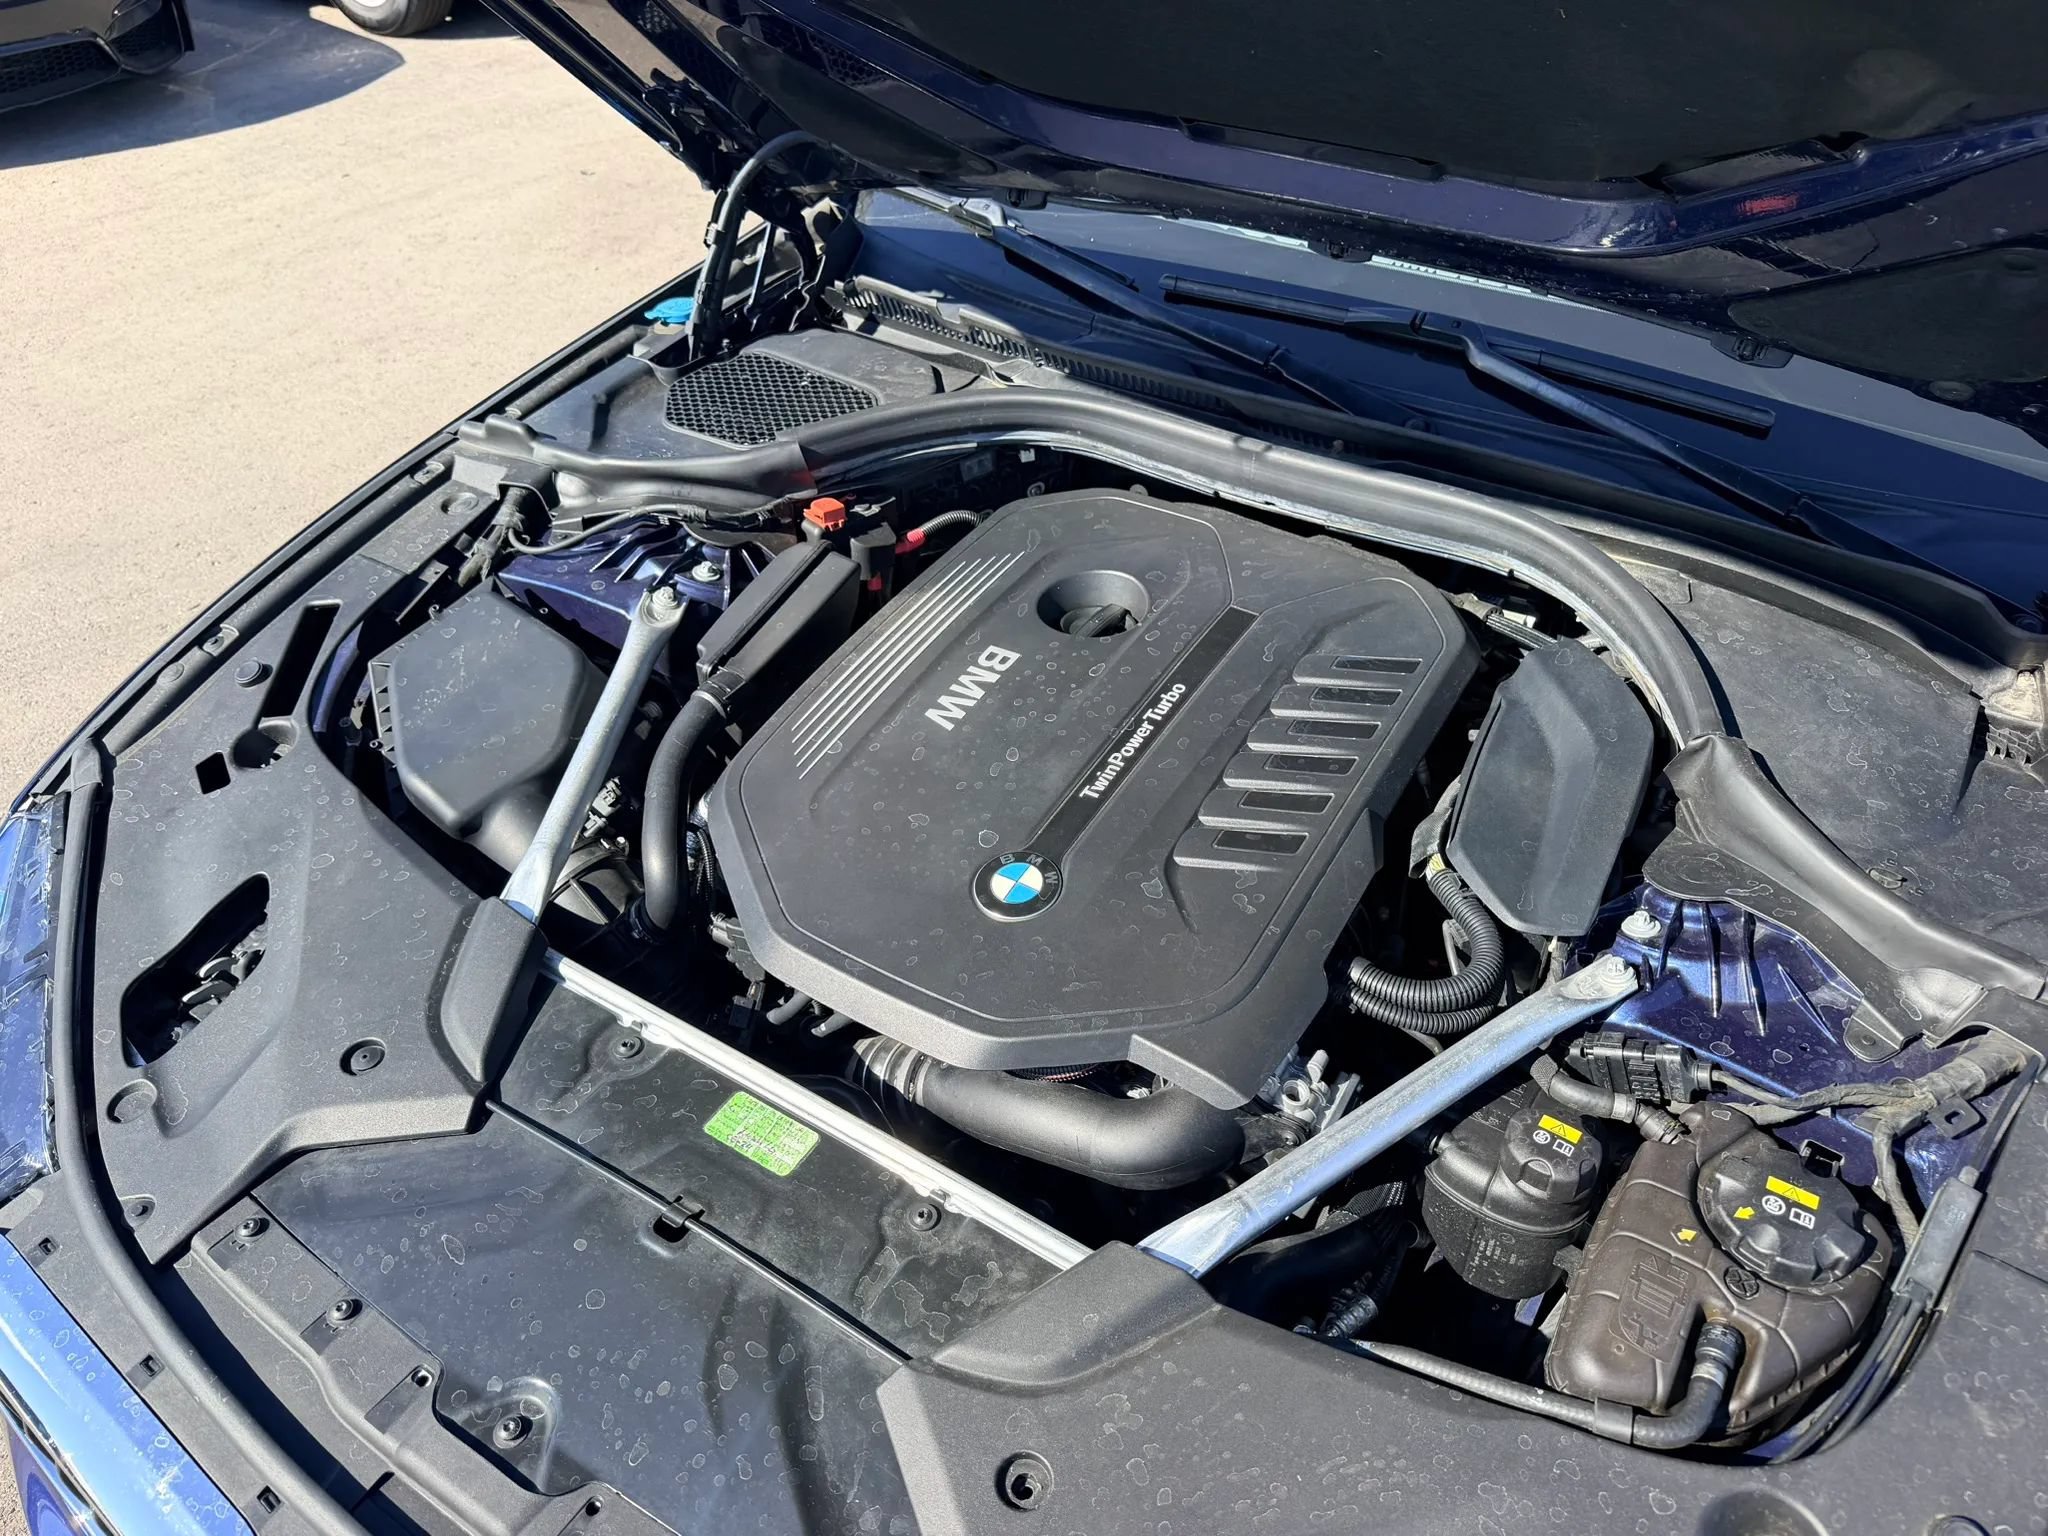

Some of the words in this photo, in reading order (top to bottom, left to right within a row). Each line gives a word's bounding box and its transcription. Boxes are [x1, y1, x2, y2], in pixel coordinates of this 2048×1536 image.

[925, 645, 1022, 731] BMW
[1078, 720, 1155, 799] TwinPower
[1143, 683, 1187, 722] Turbo
[999, 853, 1060, 885] BMW
